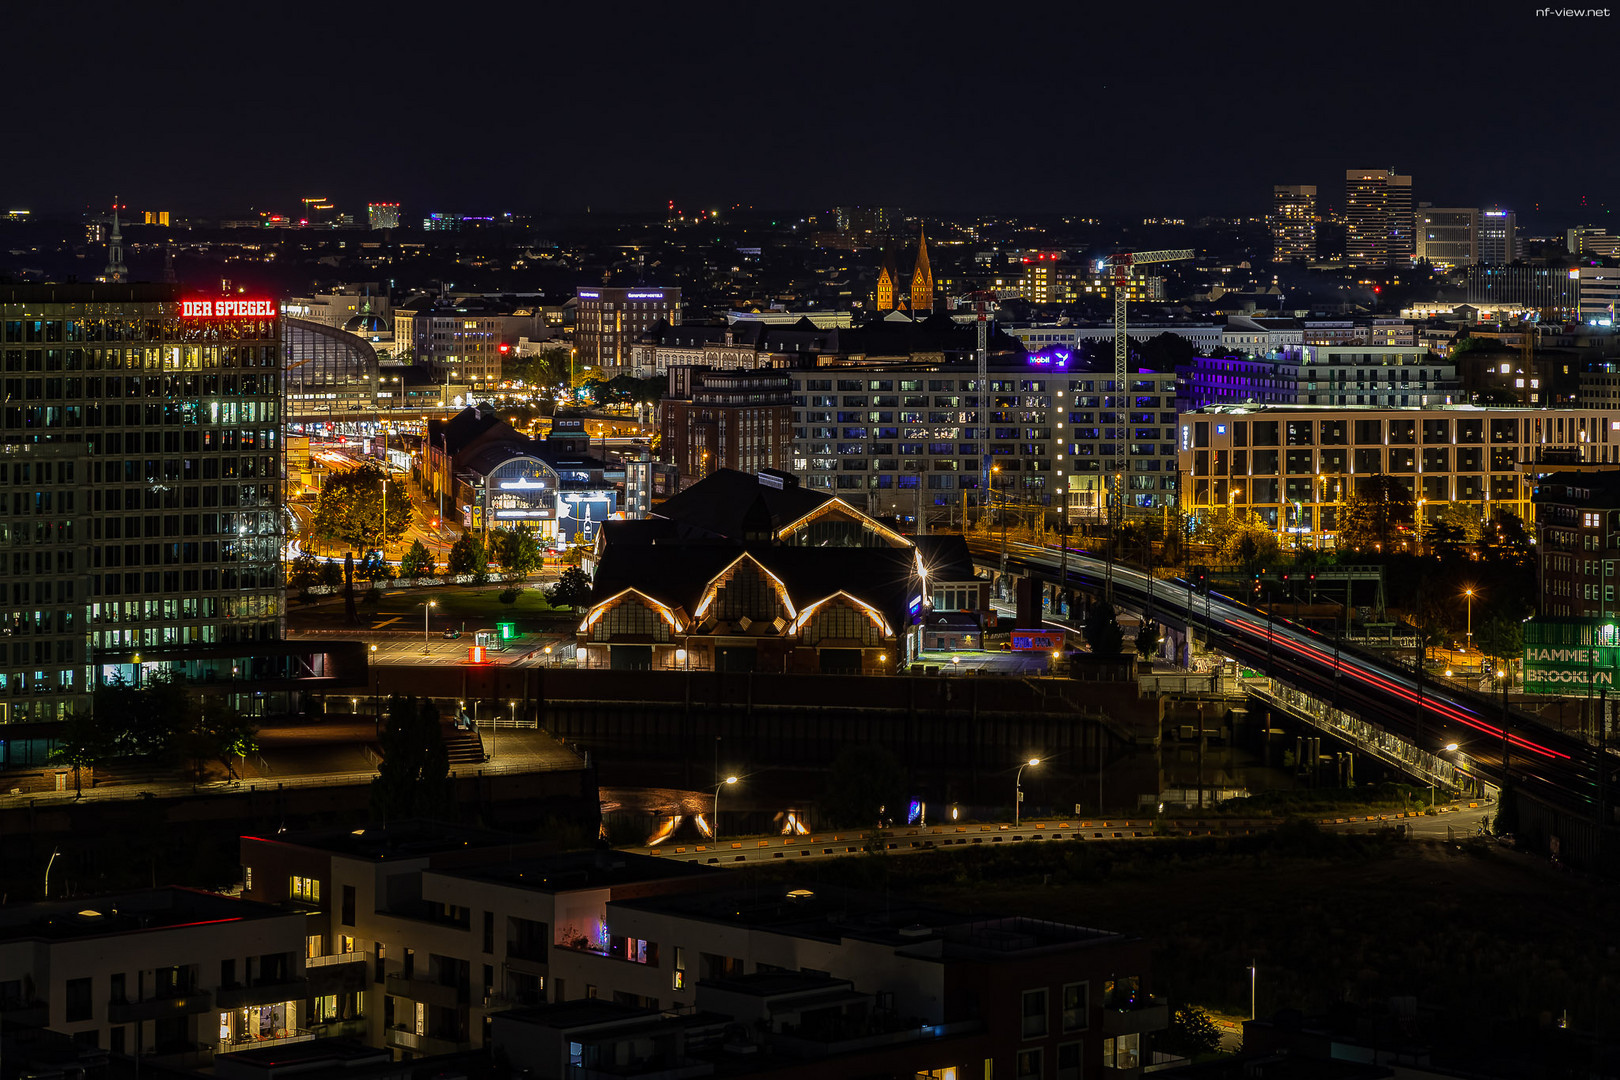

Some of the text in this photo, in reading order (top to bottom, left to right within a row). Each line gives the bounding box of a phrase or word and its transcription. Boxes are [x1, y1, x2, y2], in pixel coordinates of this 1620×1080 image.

[183, 301, 275, 316] DER SPIEGEL
[1029, 356, 1050, 364] Mobil
[1526, 648, 1600, 663] HAMMER
[1526, 669, 1613, 685] BROOKLYN
